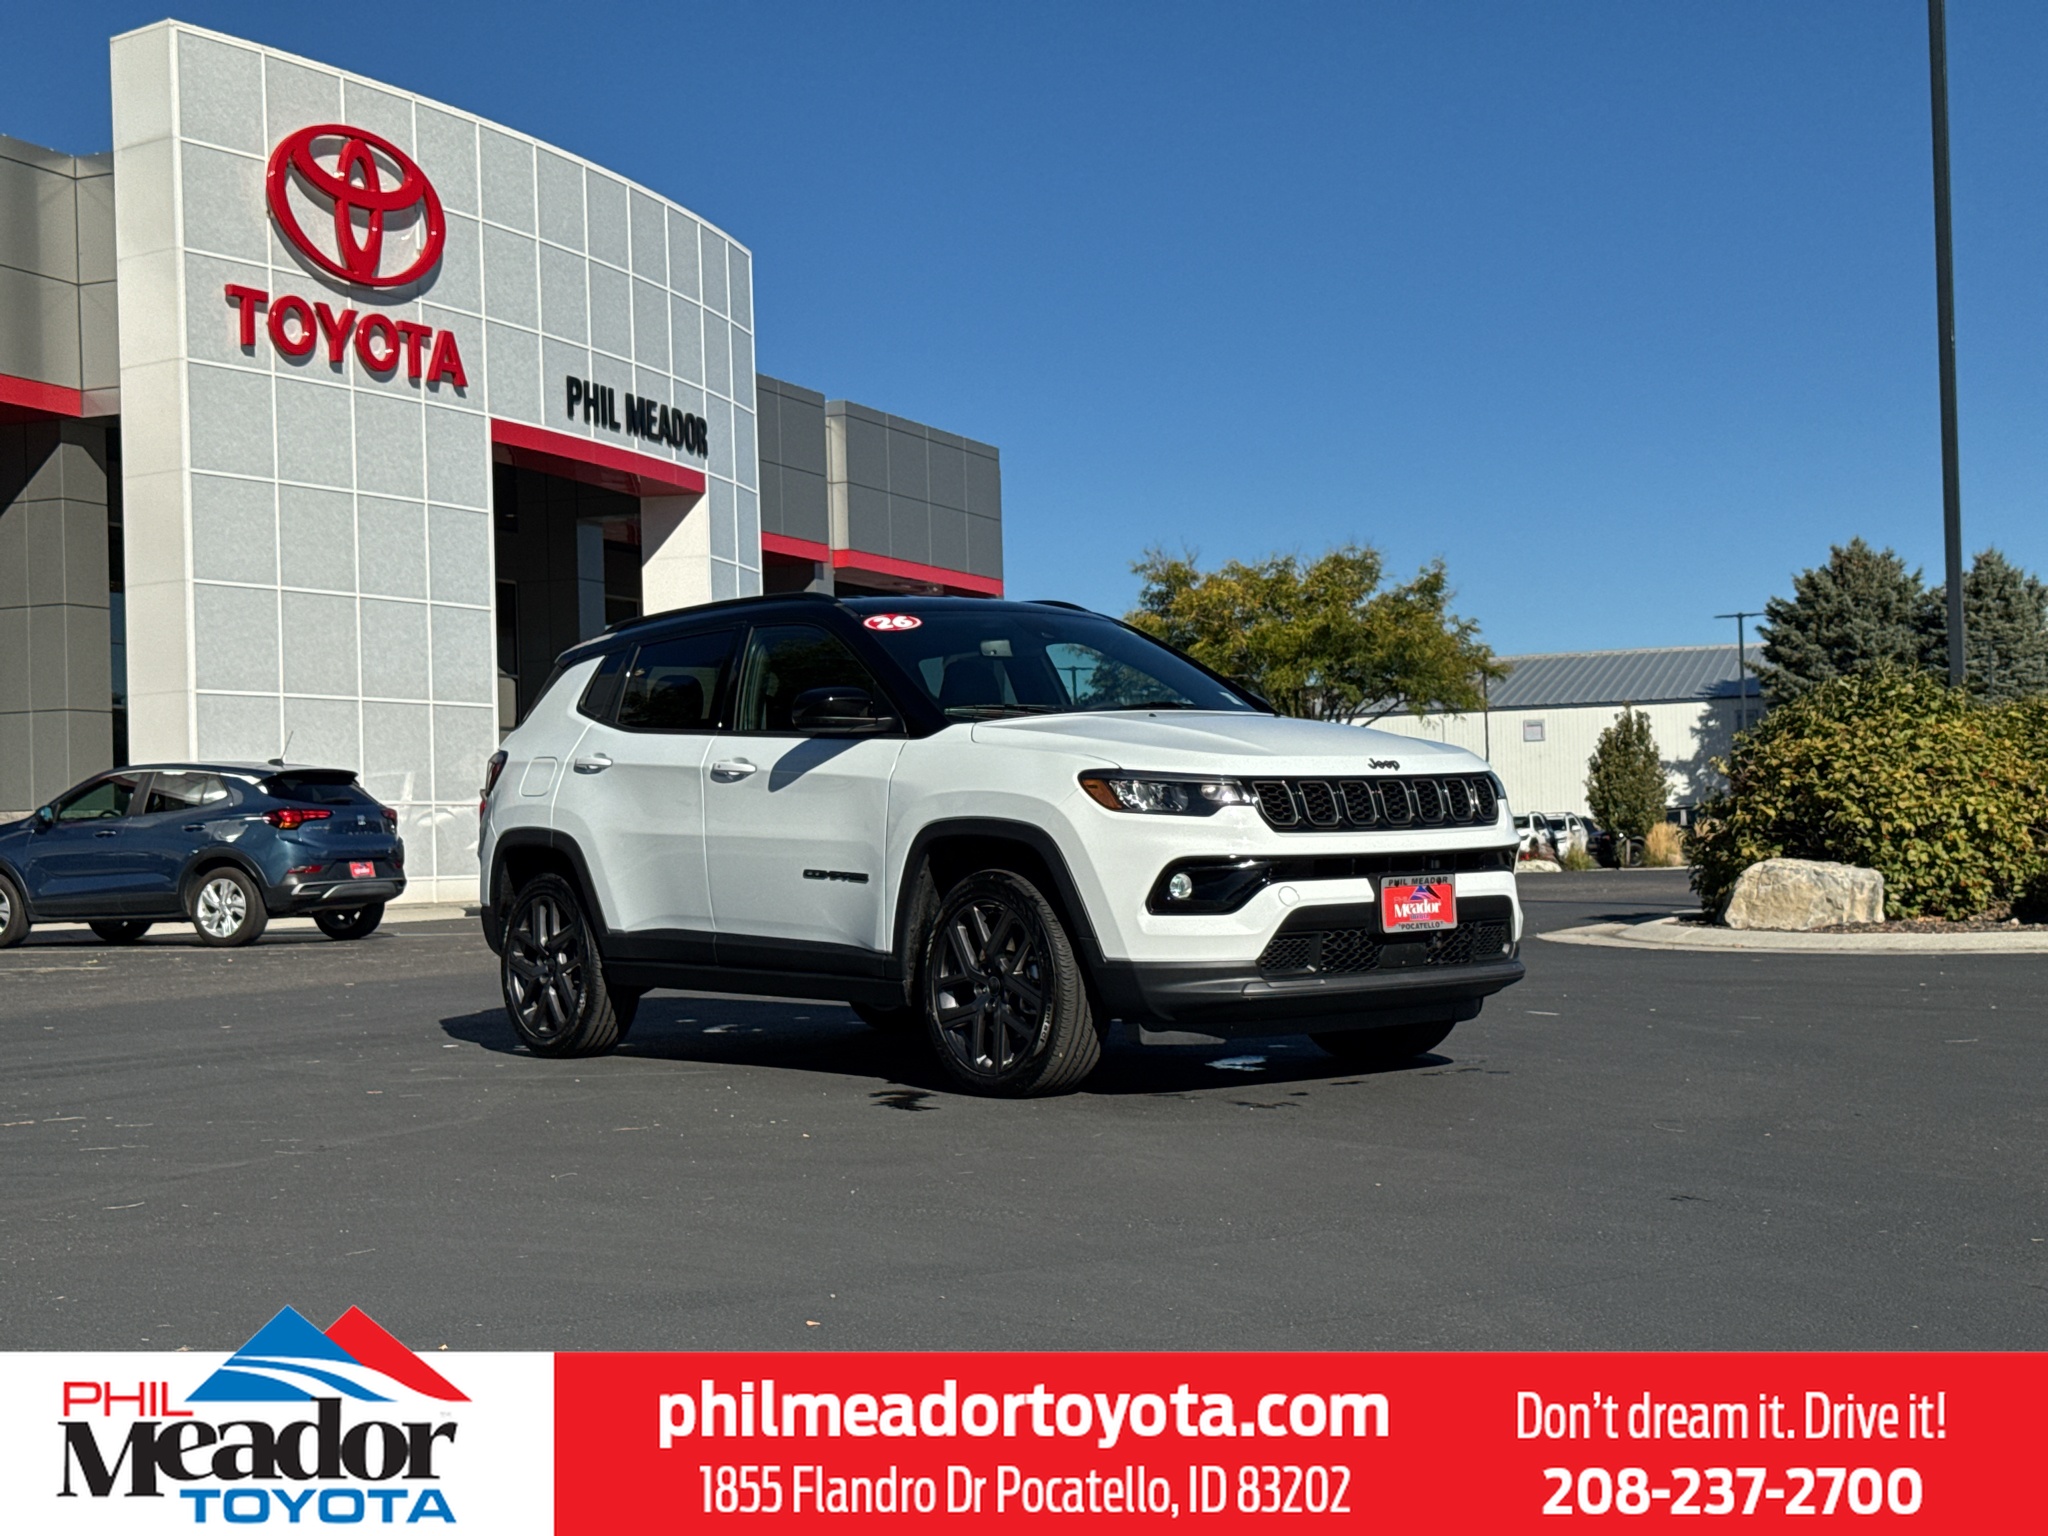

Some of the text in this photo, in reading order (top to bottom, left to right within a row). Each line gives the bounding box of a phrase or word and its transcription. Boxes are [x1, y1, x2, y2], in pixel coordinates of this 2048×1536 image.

[225, 284, 467, 387] TOYOTA
[566, 376, 709, 458] PHIL MEADOR
[873, 616, 913, 629] 26
[1367, 757, 1401, 772] Jeep
[1394, 899, 1442, 918] Meador
